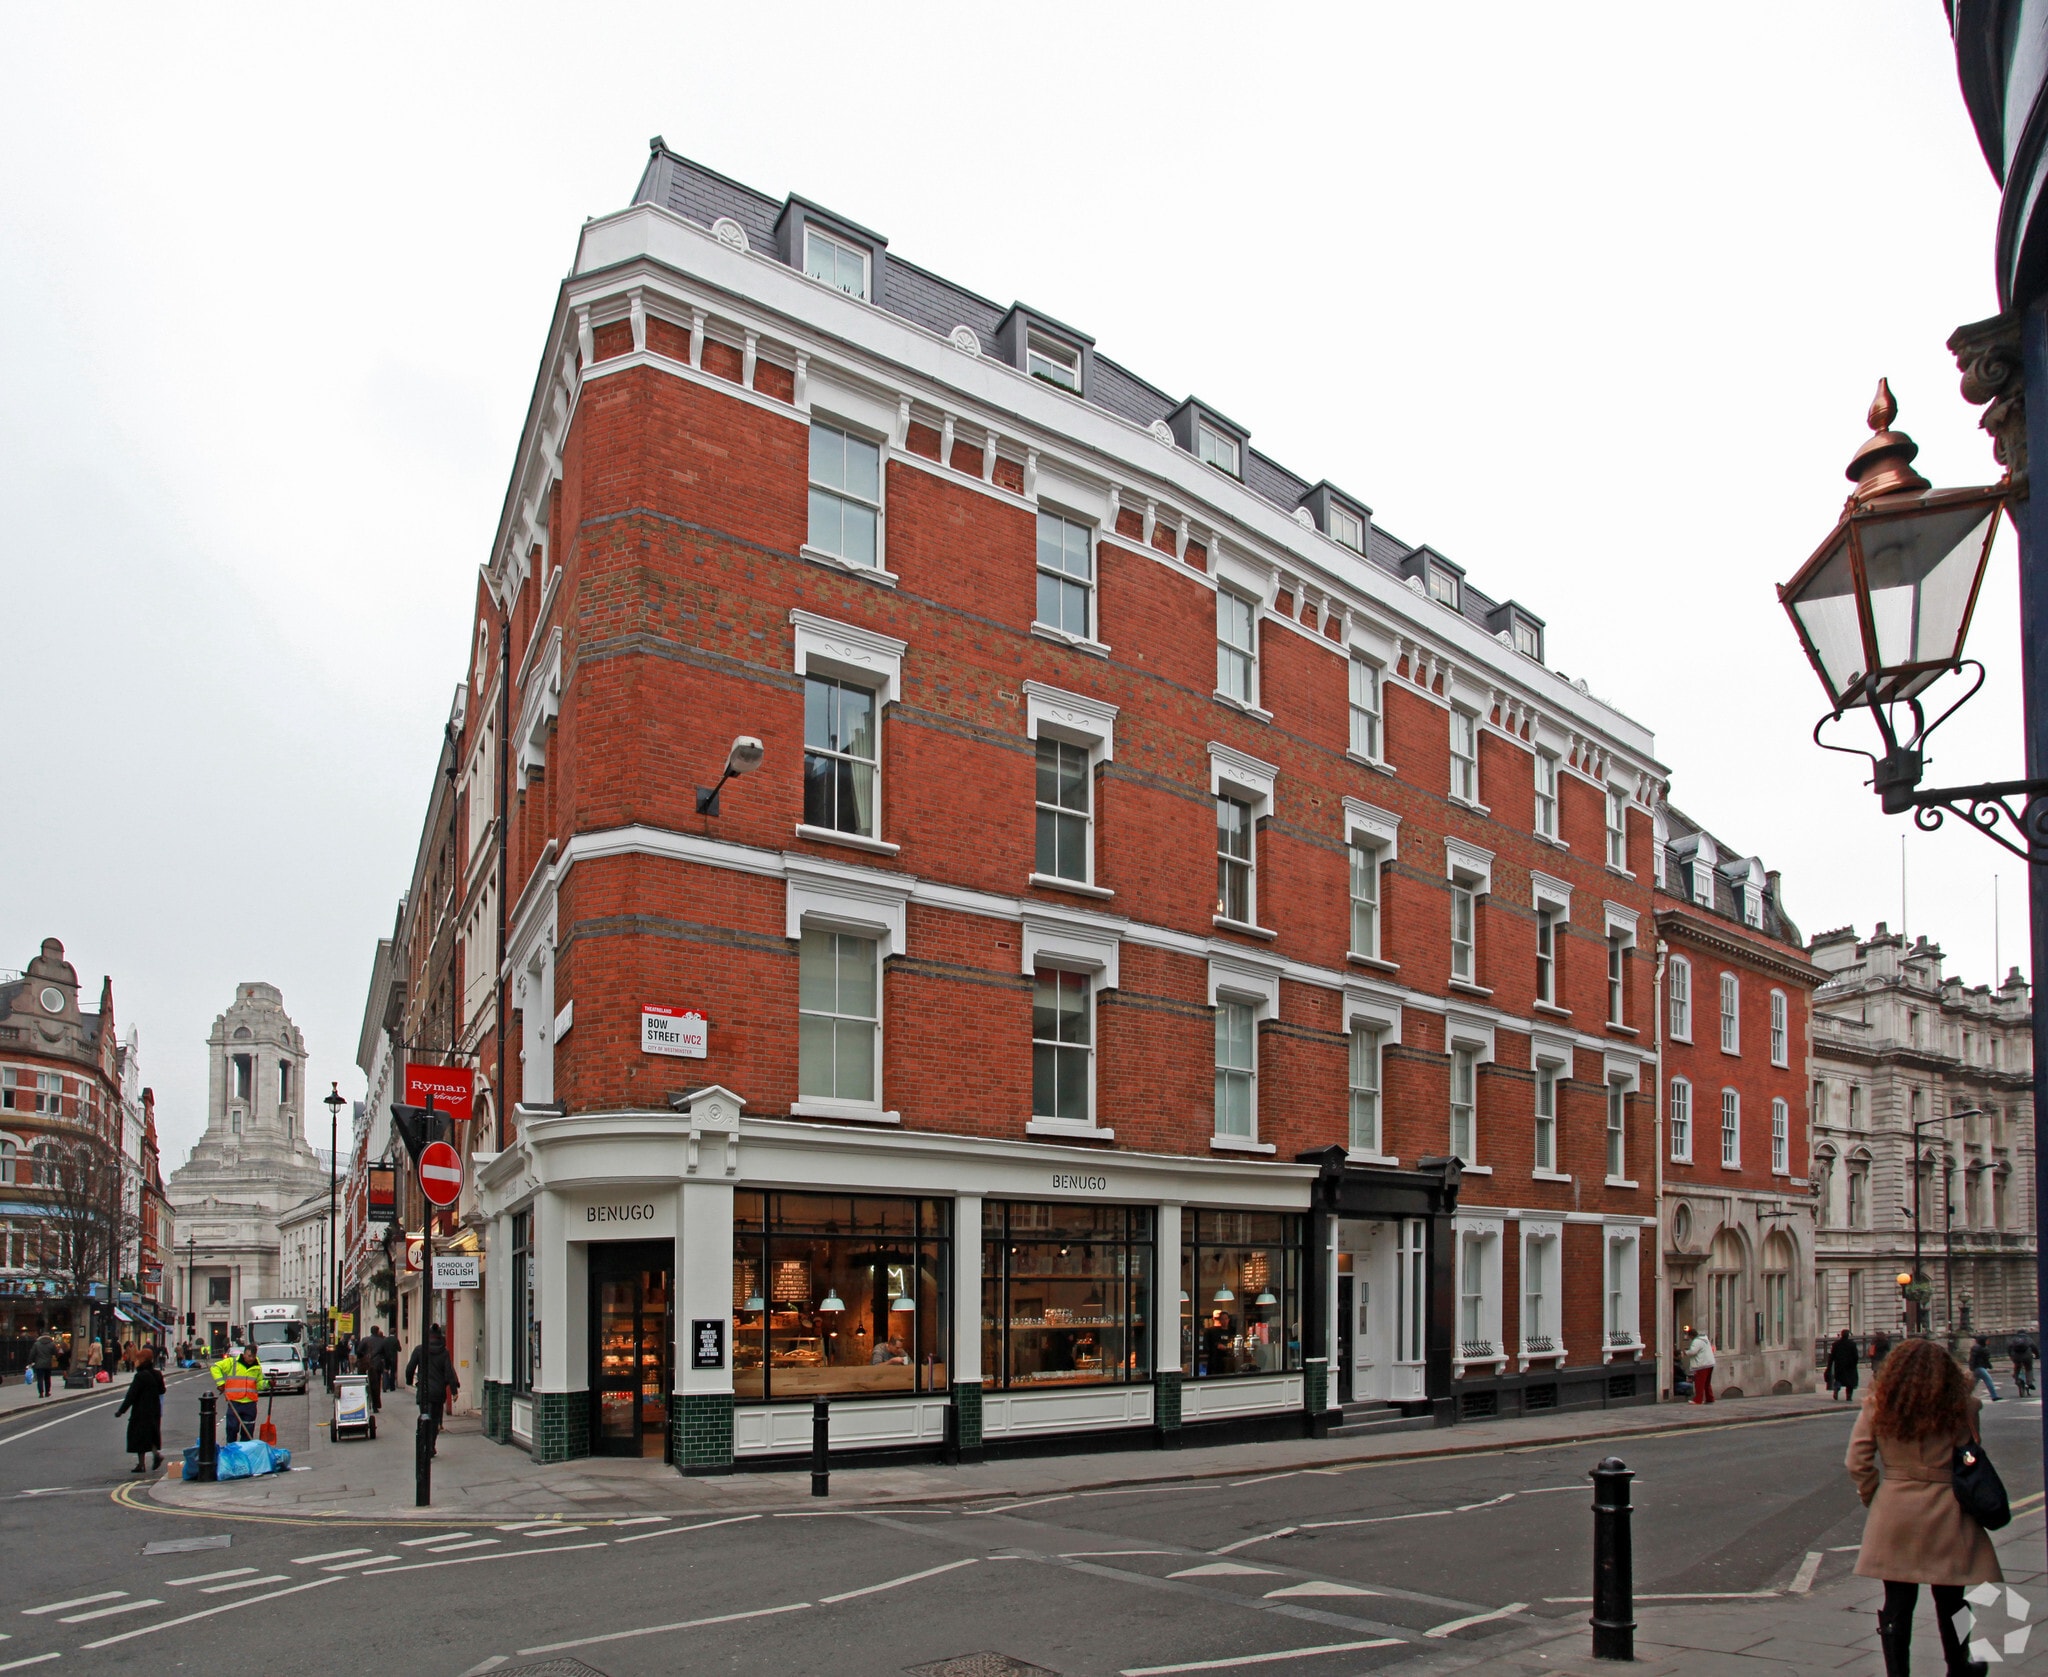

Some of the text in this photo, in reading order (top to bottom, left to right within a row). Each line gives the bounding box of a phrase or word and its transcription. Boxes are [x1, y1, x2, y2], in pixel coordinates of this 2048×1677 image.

[647, 1018, 668, 1029] BOW
[647, 1030, 702, 1045] STREET WC2
[664, 1047, 693, 1055] WESTMINSTER
[411, 1080, 467, 1094] Ryman
[1052, 1174, 1106, 1190] BENUGO
[587, 1204, 654, 1222] BENUGO
